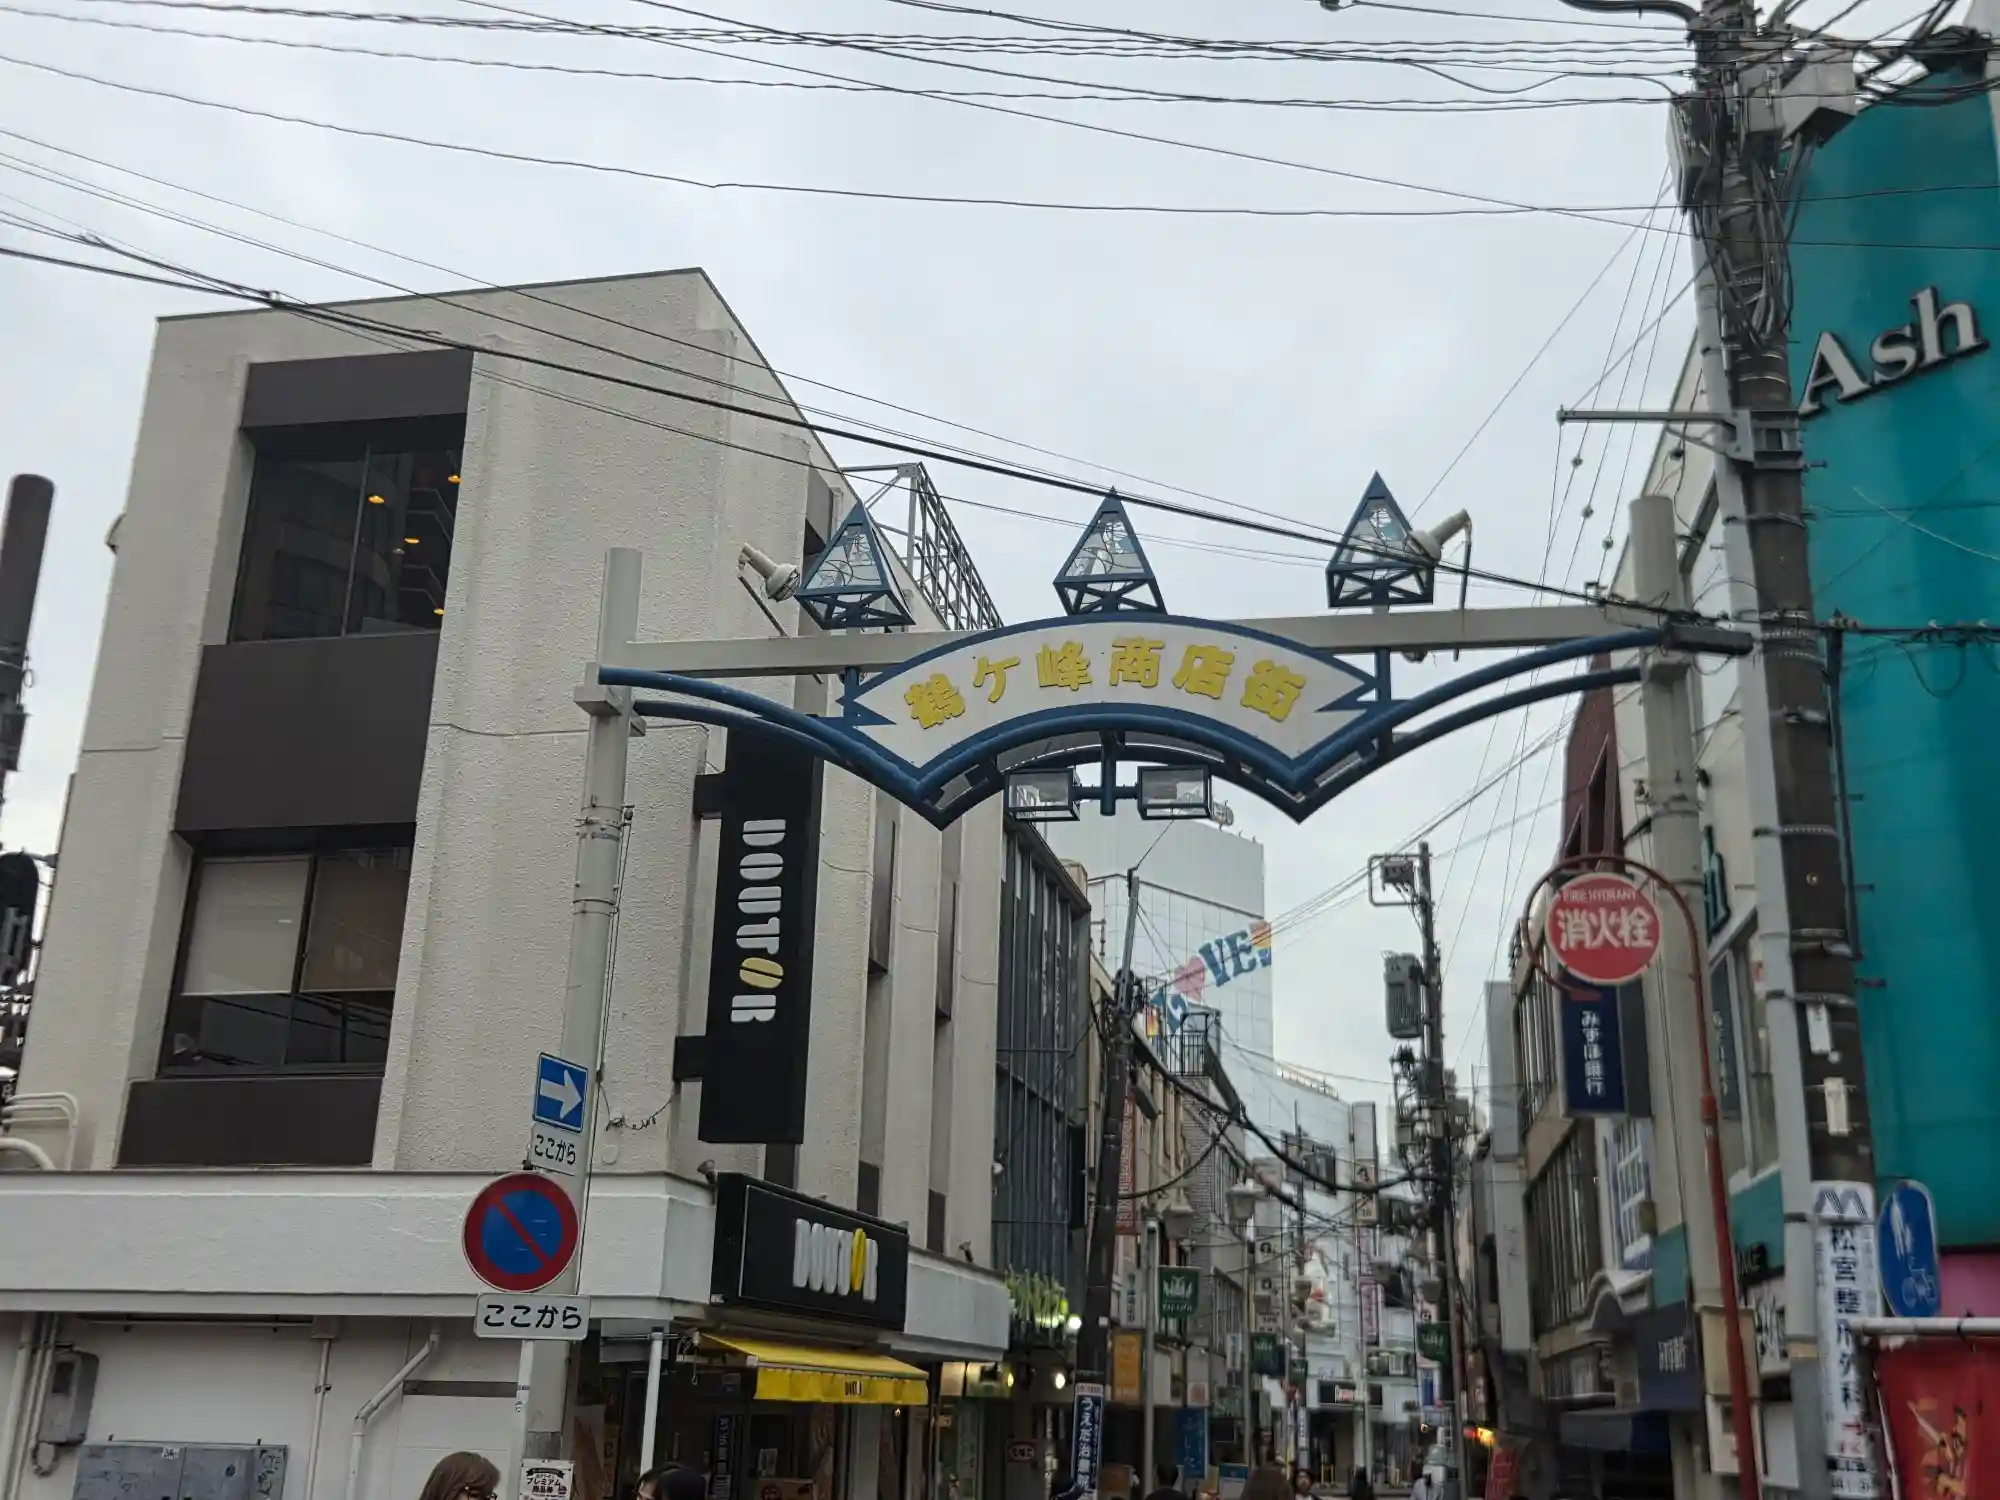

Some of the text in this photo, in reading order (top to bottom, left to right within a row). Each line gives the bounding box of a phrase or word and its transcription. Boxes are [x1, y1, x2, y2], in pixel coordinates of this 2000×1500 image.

[1798, 285, 1986, 417] Ash
[730, 818, 787, 1023] DOUTOR
[1556, 905, 1655, 950] 消火栓
[1580, 1009, 1604, 1098] みずほ銀行
[533, 1134, 577, 1166] ここから
[482, 1303, 582, 1330] ここから
[526, 1477, 561, 1486] プレミアム
